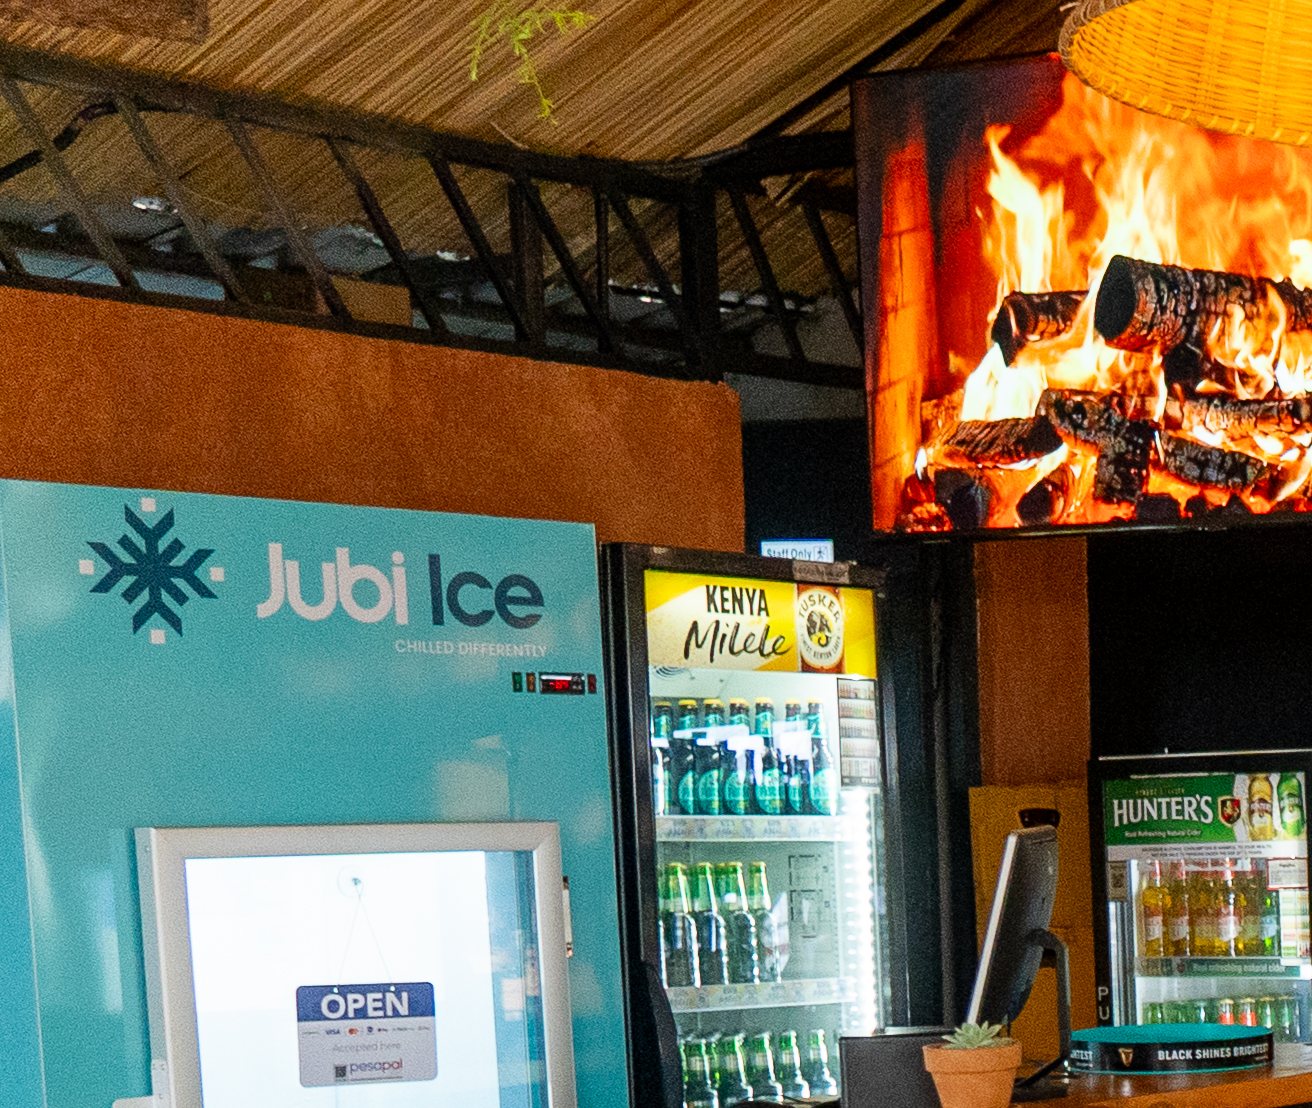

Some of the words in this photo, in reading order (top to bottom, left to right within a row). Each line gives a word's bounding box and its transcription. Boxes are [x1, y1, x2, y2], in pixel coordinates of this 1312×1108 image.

[257, 543, 409, 626] Jubi
[428, 552, 546, 629] Ice
[705, 584, 770, 617] KENYA
[797, 593, 841, 623] TUSKER
[395, 640, 454, 655] CHILLED
[458, 642, 548, 658] DIFFERENTLY
[683, 619, 794, 664] Milele
[1113, 794, 1214, 828] HUNTER'S
[320, 991, 409, 1019] OPEN
[349, 1057, 403, 1075] pesapal
[1157, 1049, 1193, 1061] BLACK
[1195, 1046, 1232, 1060] SHINES
[1233, 1042, 1269, 1057] BRIGHTEST
